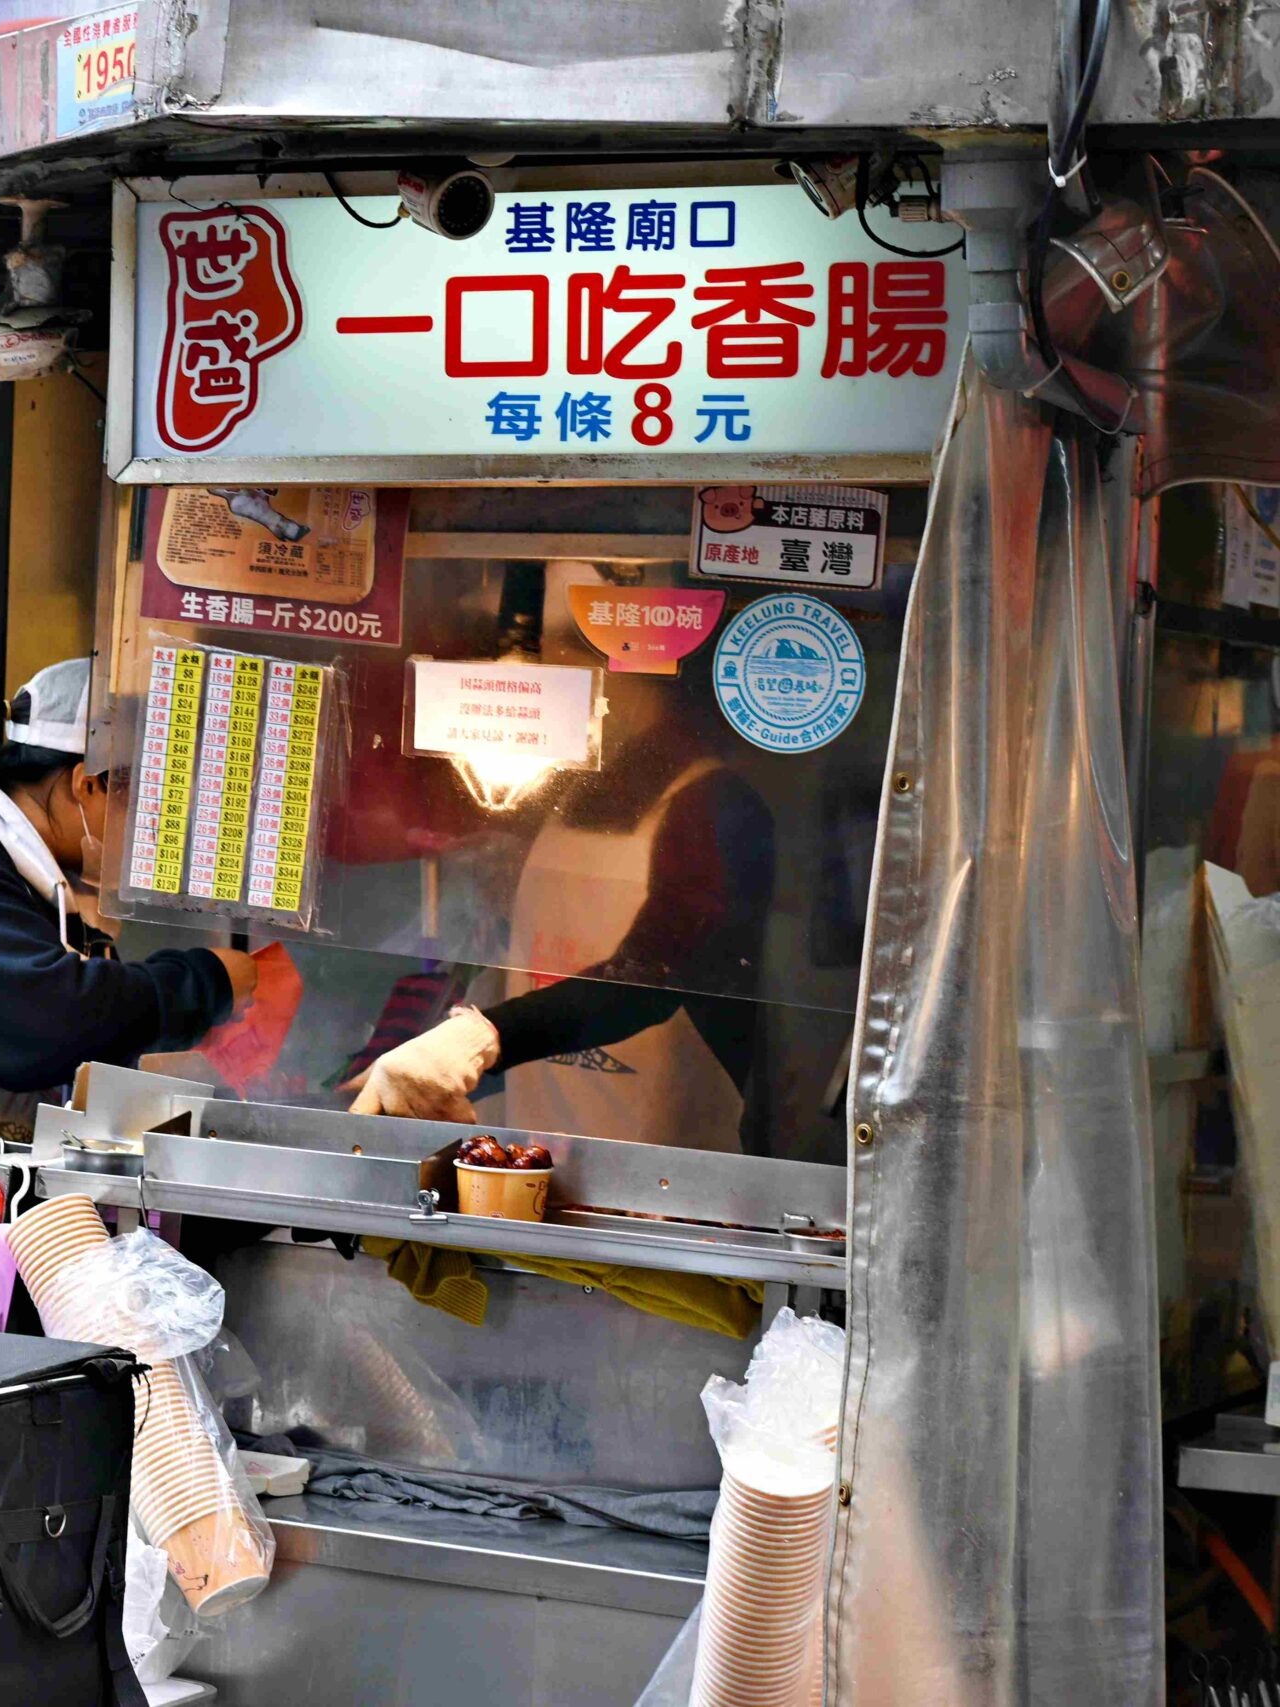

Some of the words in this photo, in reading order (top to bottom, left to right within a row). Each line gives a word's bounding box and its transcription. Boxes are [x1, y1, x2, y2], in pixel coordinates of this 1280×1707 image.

[505, 200, 736, 253] 基隆廟口
[176, 224, 252, 397] 世盛
[336, 261, 946, 380] 一口吃香腸
[771, 504, 865, 531] 本店豬原料
[704, 542, 759, 566] 原產地
[779, 538, 853, 576] 臺灣
[588, 600, 703, 630] 基隆100碗
[730, 602, 795, 647] KEELUNG
[802, 603, 852, 654] TRAVEL
[183, 669, 193, 679] $8
[237, 676, 257, 687] $128
[297, 684, 317, 695] $248
[235, 691, 256, 702] $136
[178, 699, 192, 709] $24
[295, 699, 316, 710] $256
[234, 706, 254, 717] $144
[176, 714, 191, 725] $32
[294, 715, 314, 725] $264
[232, 721, 253, 732] $152
[175, 729, 189, 740] $40
[292, 730, 313, 740] $272
[231, 736, 251, 747] $160
[173, 744, 188, 755] $48
[290, 745, 311, 755] $280
[229, 751, 250, 762] $168
[172, 759, 186, 770] $56
[289, 760, 309, 771] $288
[228, 766, 248, 777] $176
[170, 774, 185, 785] $64
[287, 775, 308, 786] $296
[226, 782, 247, 792] $184
[169, 790, 183, 800] $72
[286, 790, 306, 801] $304
[225, 797, 245, 807] $192
[167, 805, 182, 815] $80
[284, 806, 305, 816] $312
[223, 812, 244, 822] $200
[166, 820, 180, 830] $88
[283, 821, 303, 831] $320
[222, 827, 242, 837] $208
[164, 835, 179, 845] $96
[281, 836, 302, 847] $328
[220, 842, 241, 852] $216
[160, 850, 180, 861] $104
[279, 851, 300, 862] $336
[219, 857, 239, 867] $224
[158, 865, 179, 876] $112
[278, 866, 298, 877] $344
[217, 872, 238, 882] $232
[157, 880, 177, 891] $120
[276, 882, 297, 892] $352
[216, 887, 236, 897] $240
[275, 897, 295, 907] $360
